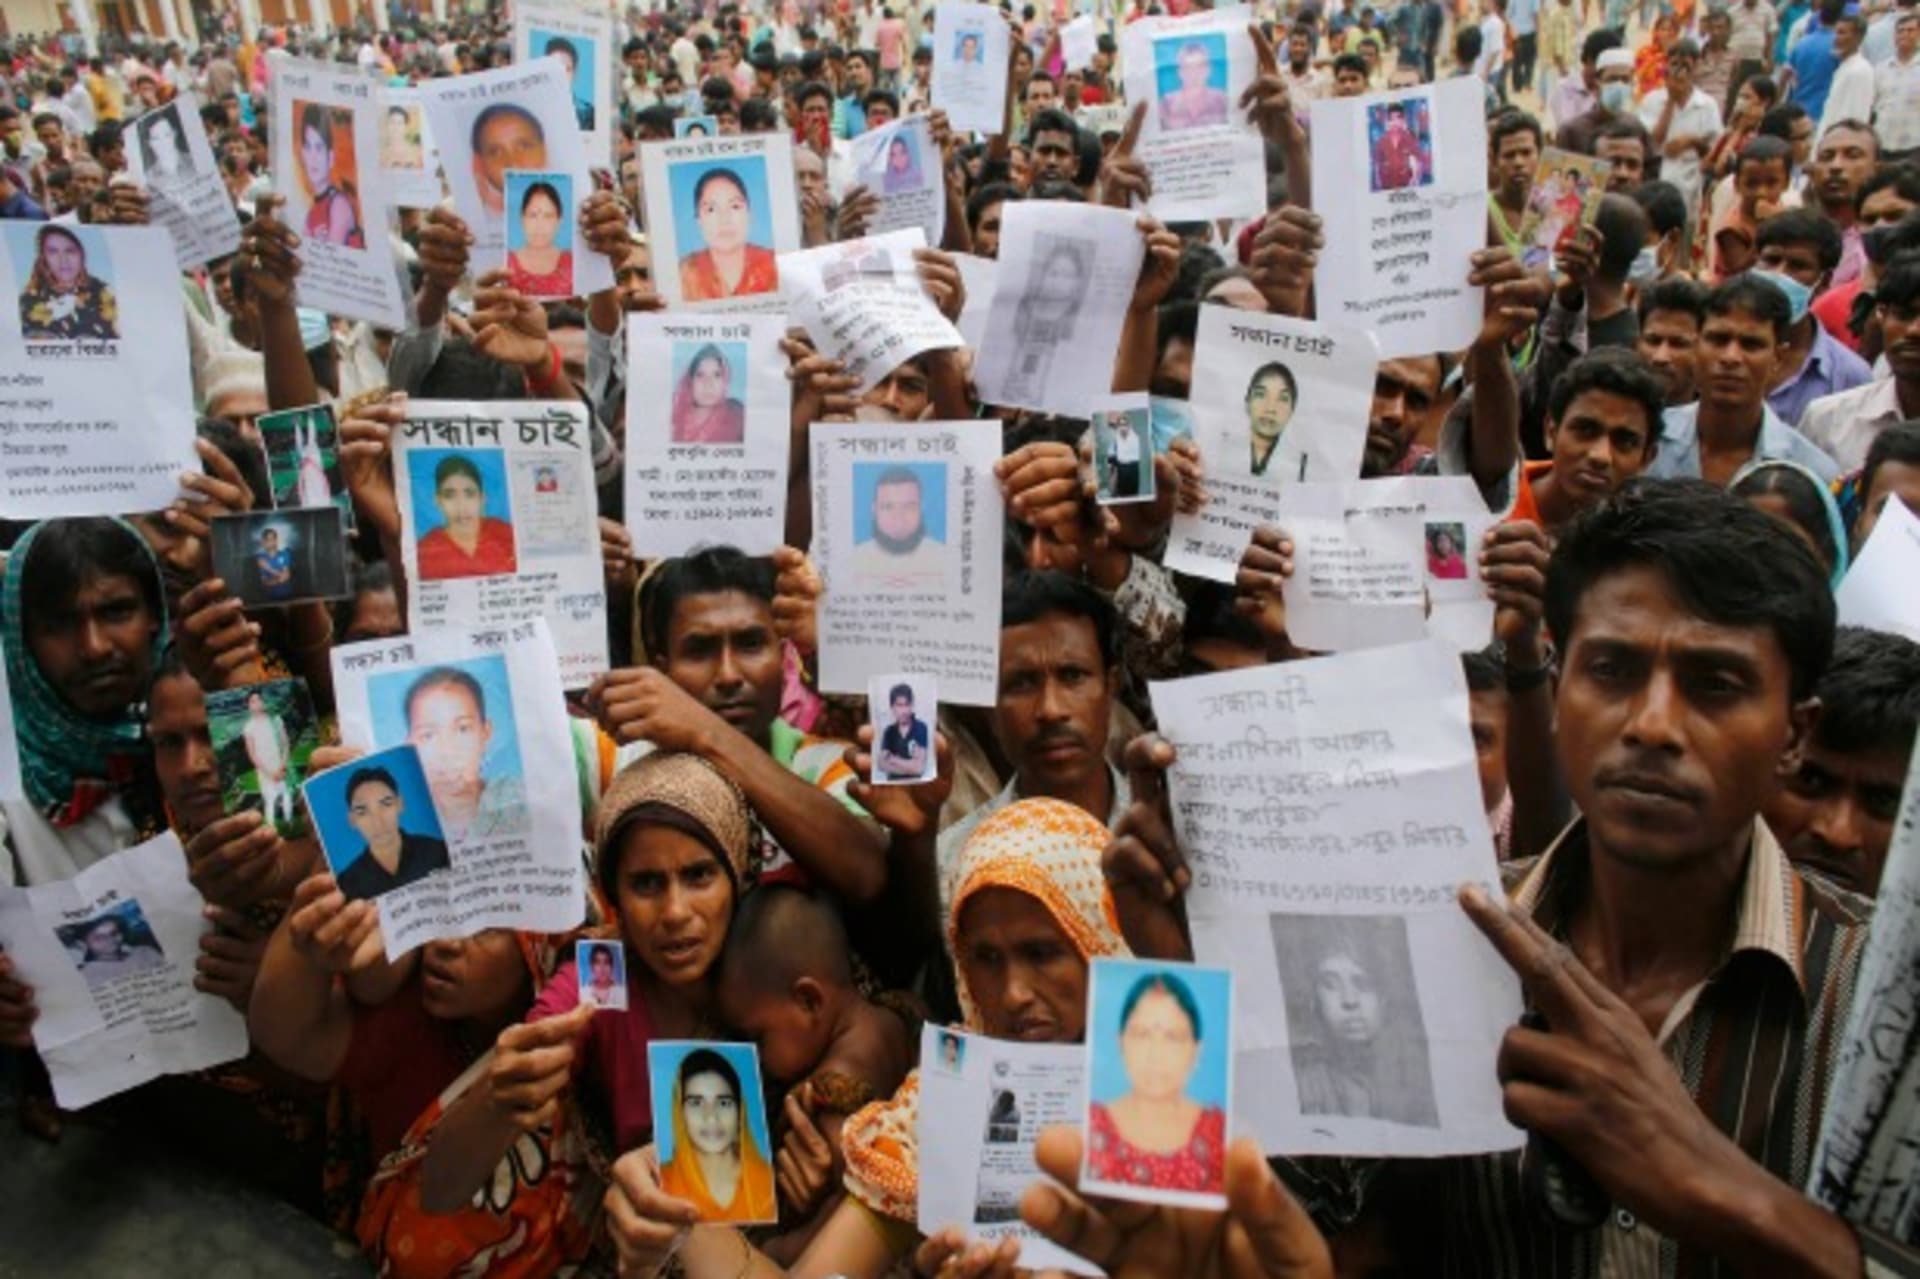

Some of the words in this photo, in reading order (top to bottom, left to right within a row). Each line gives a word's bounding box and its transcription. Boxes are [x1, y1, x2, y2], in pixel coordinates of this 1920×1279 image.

[402, 413, 504, 447] সন্ধান
[513, 407, 583, 450] চাই
[838, 436, 907, 455] সন্ধান
[917, 432, 960, 456] চাই
